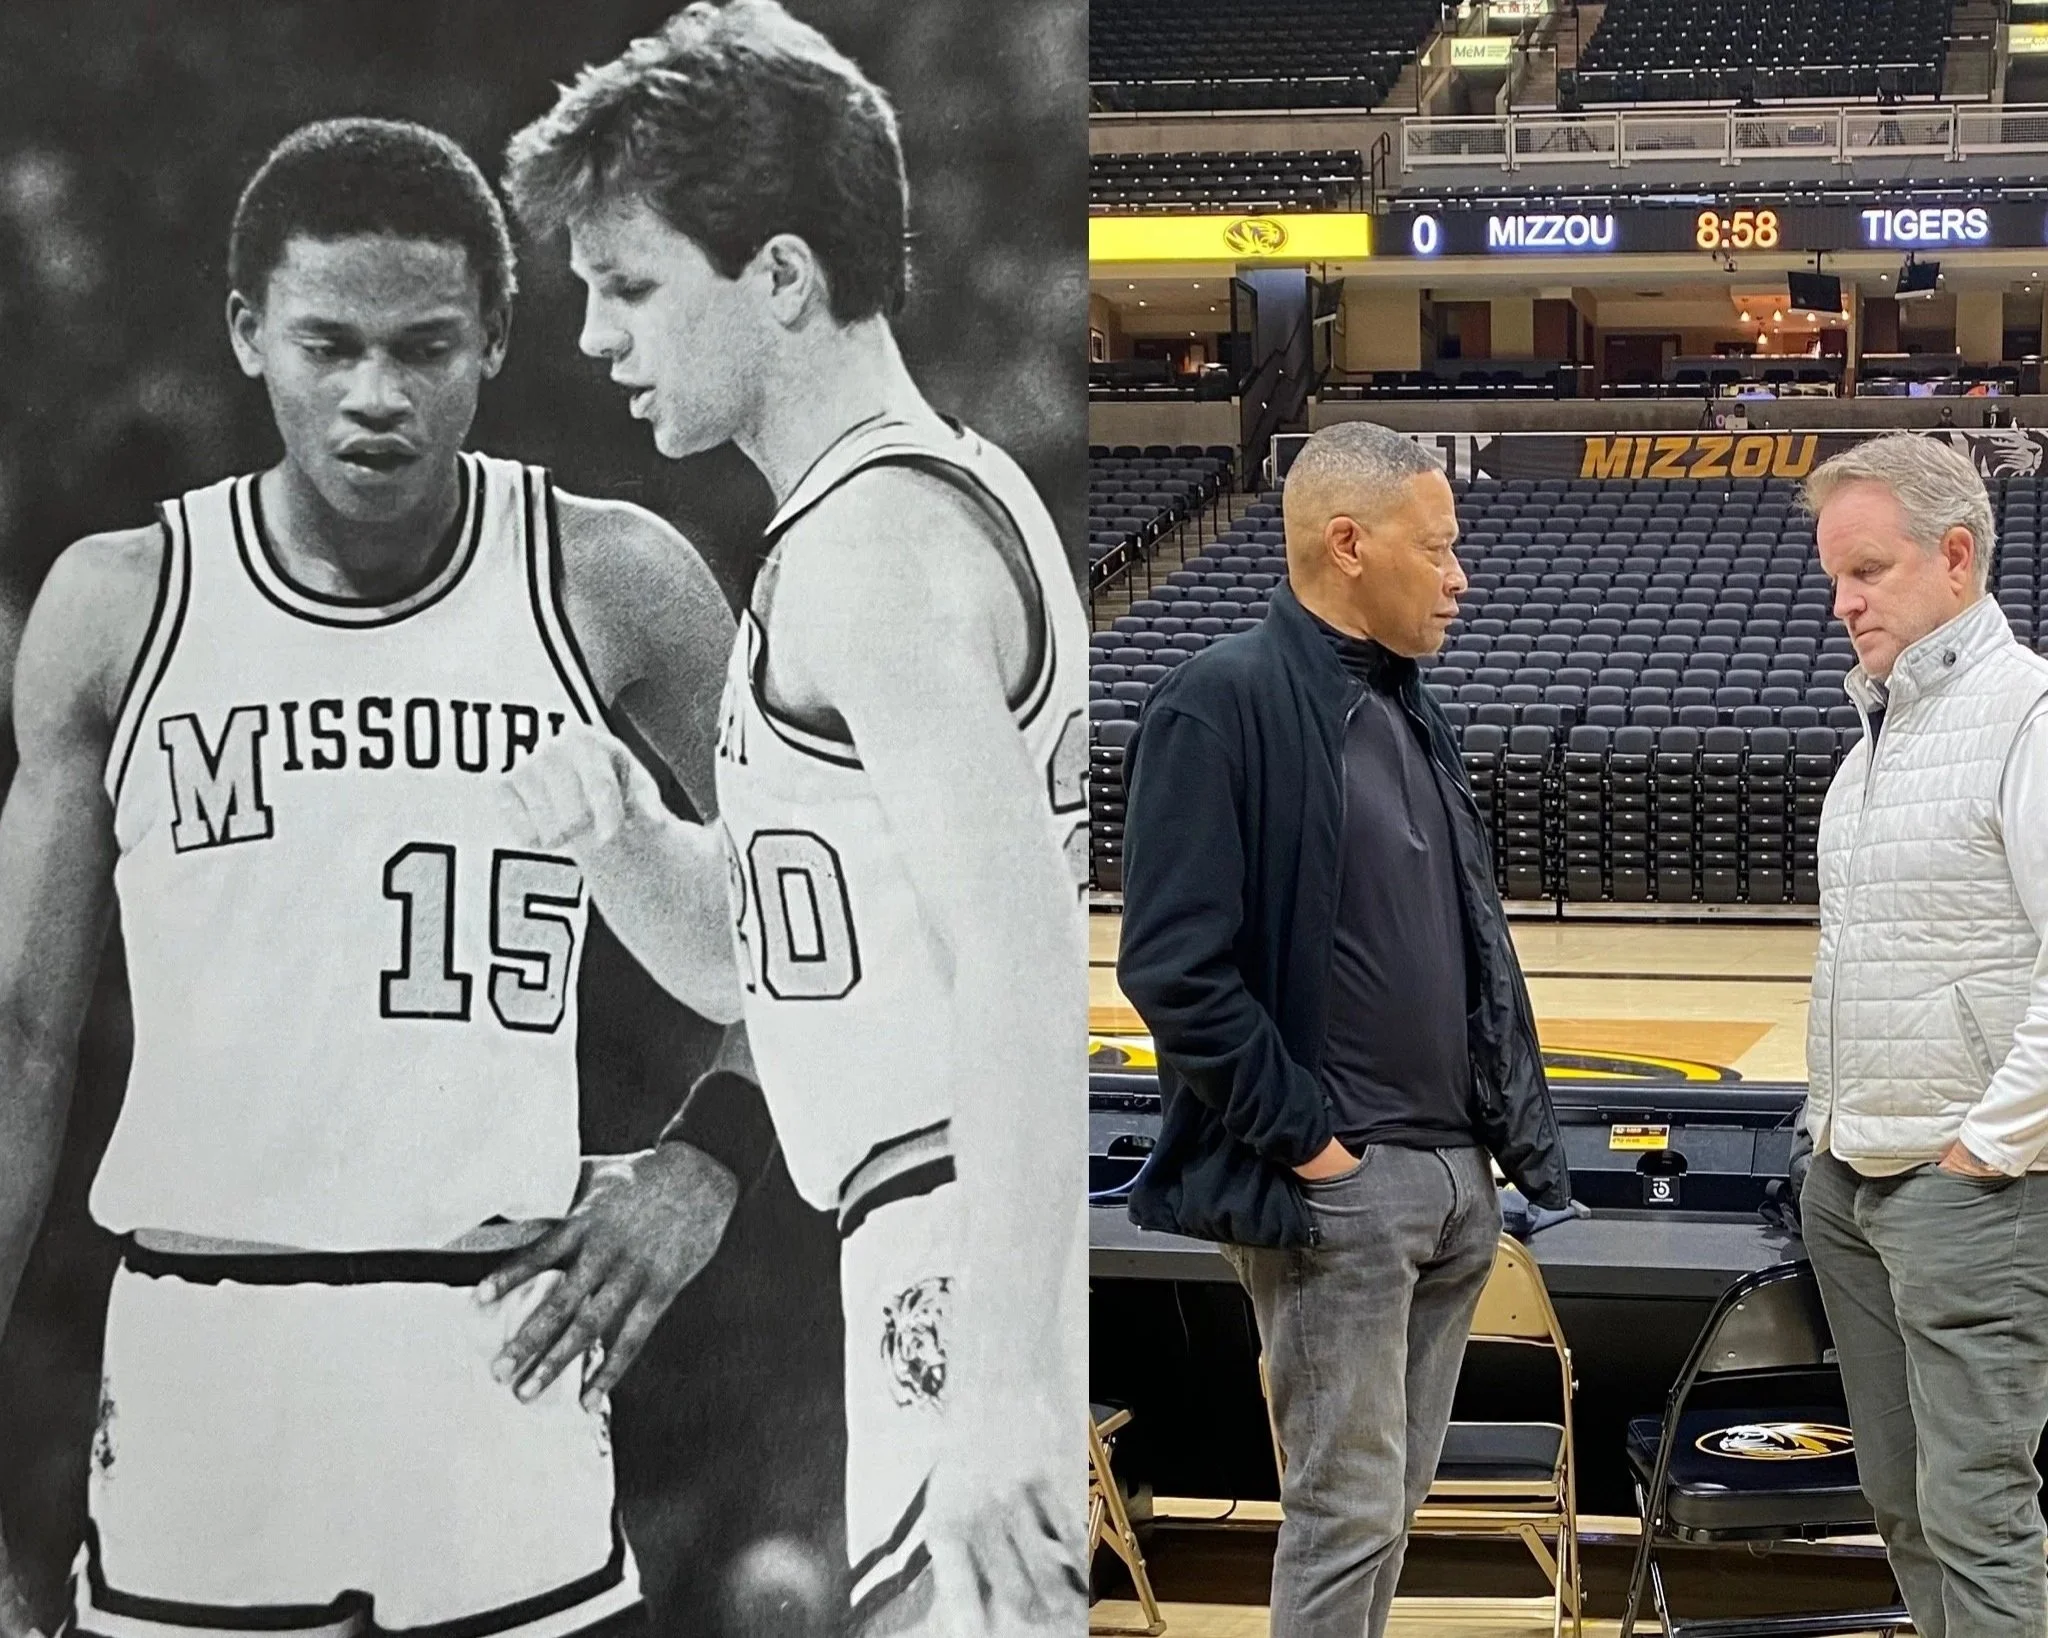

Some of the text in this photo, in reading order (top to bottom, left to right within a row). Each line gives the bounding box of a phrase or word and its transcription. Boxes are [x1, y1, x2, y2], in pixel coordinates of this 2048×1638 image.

[1412, 214, 1438, 254] 0
[1488, 214, 1614, 246] MIZZOU
[1696, 210, 1779, 249] 8:58
[1861, 207, 1989, 242] TIGERS
[1580, 434, 1818, 479] MIZZOU
[159, 696, 566, 853] MISSOUR
[380, 841, 585, 1034] 15
